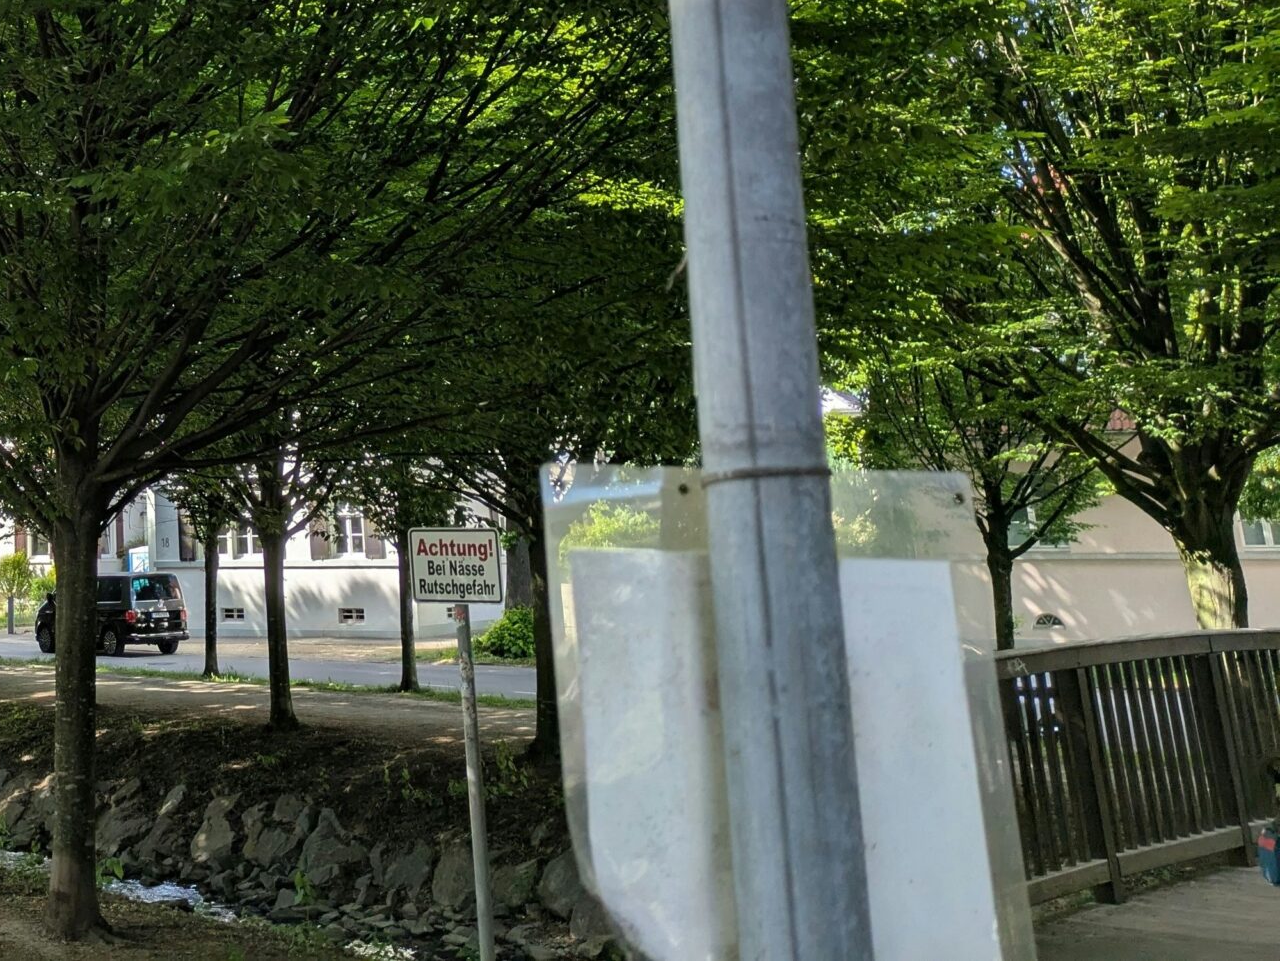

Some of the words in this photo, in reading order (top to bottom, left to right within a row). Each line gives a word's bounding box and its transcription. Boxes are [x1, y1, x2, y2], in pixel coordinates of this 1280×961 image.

[161, 537, 170, 548] 18
[416, 538, 494, 562] Achtung!
[427, 560, 446, 576] Bei
[449, 560, 485, 576] Nässe
[419, 578, 496, 599] Rutschgefahr
